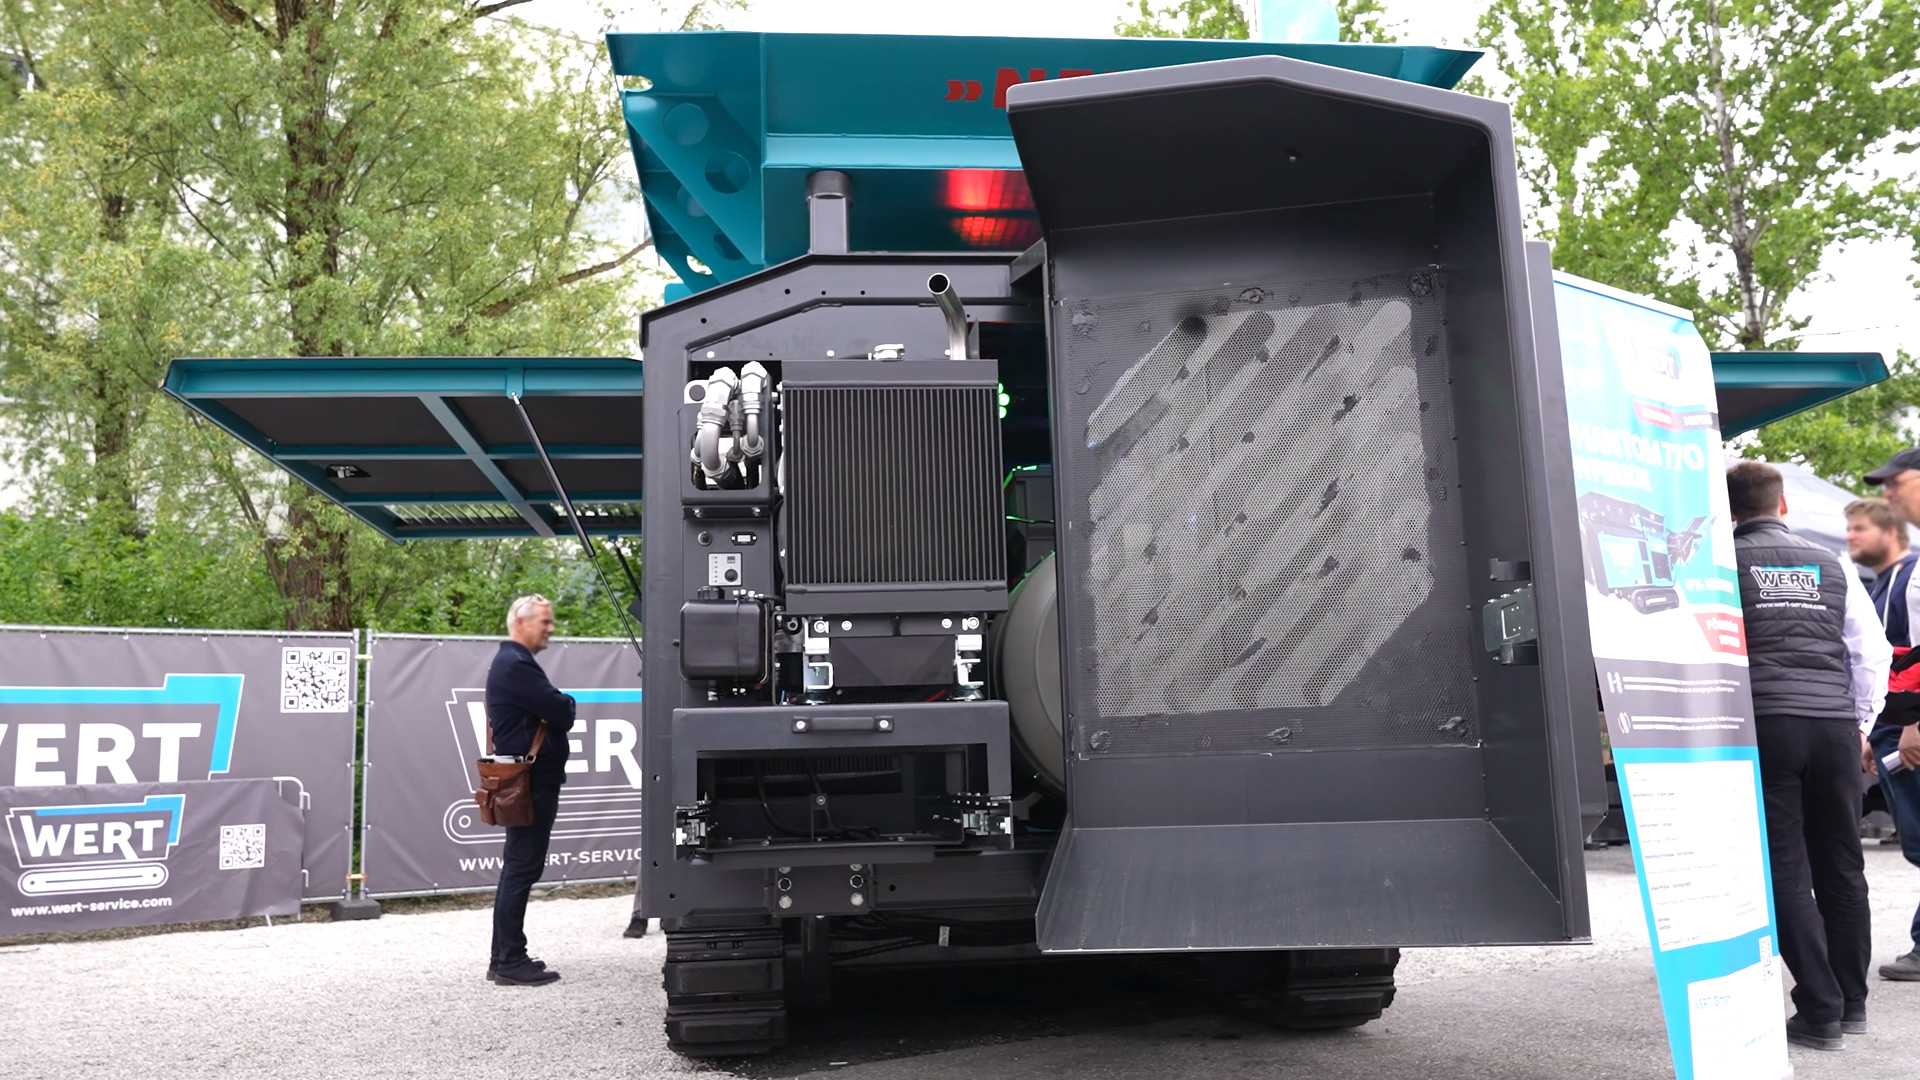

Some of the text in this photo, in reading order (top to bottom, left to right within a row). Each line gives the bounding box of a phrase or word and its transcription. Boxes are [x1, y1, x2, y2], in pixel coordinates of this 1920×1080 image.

[1751, 566, 1818, 590] WERT
[0, 722, 202, 787] ERT
[466, 702, 642, 789] ER
[19, 815, 164, 861] WERT
[11, 895, 173, 918] www.wert-service.com
